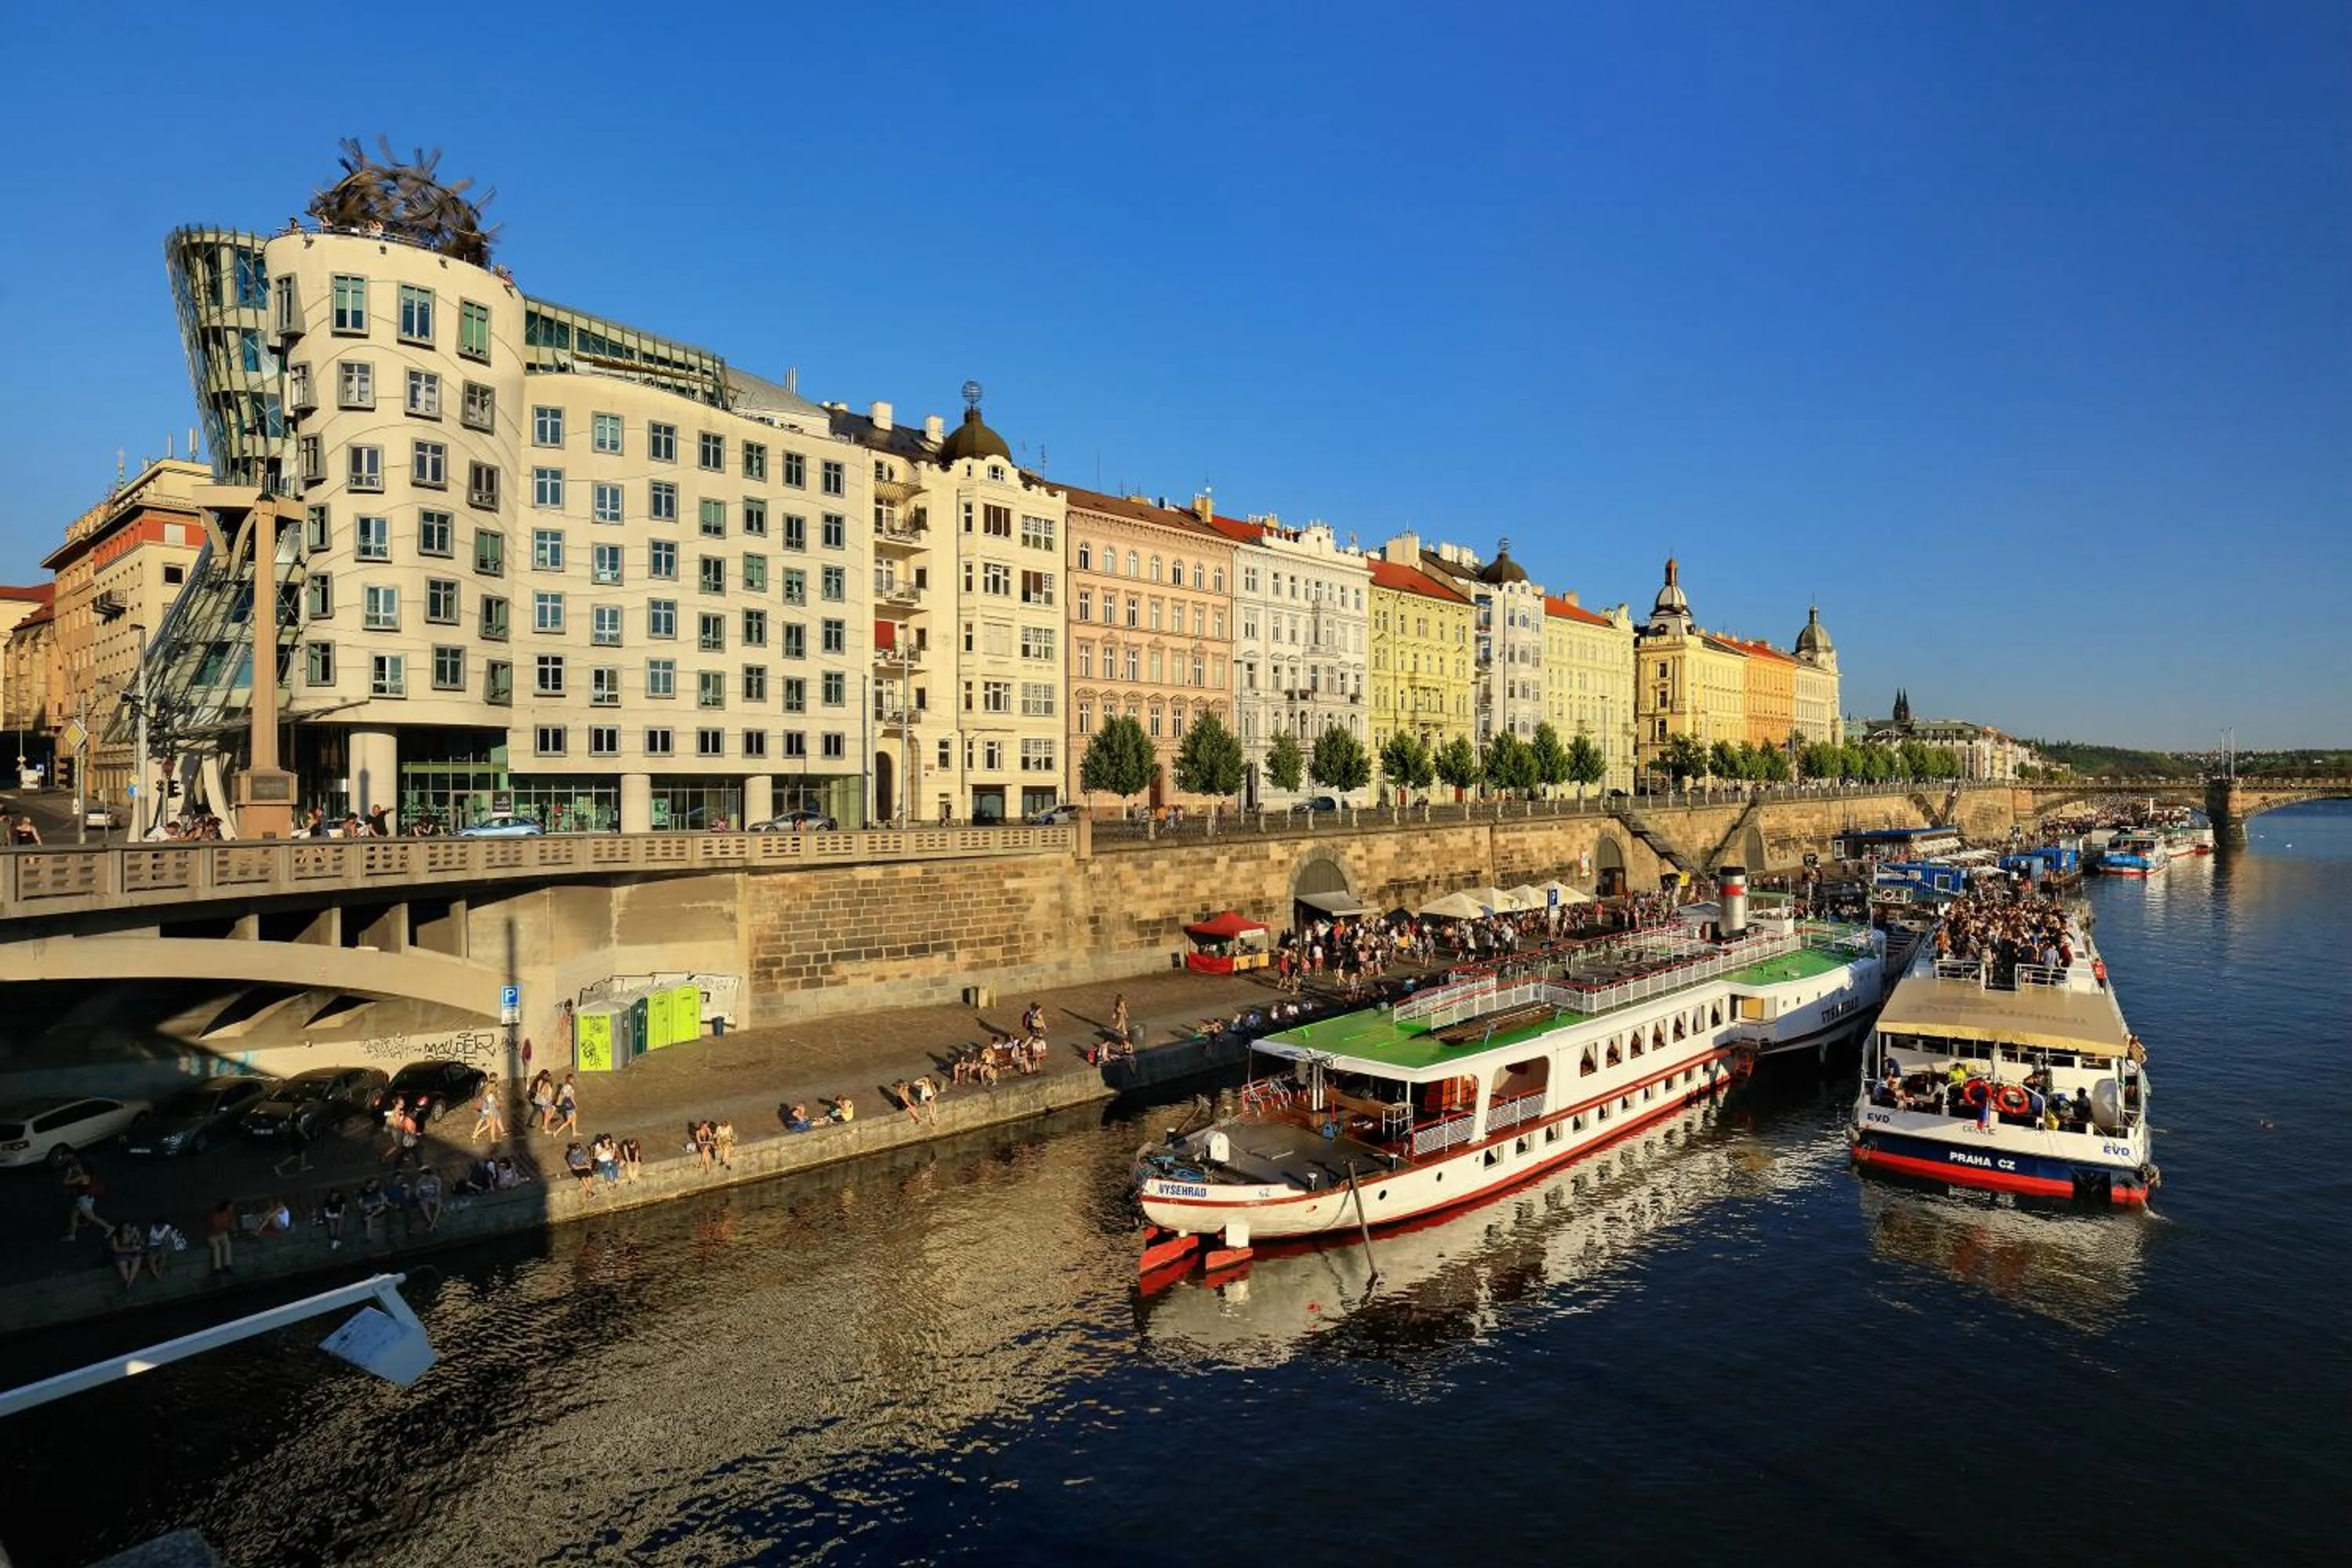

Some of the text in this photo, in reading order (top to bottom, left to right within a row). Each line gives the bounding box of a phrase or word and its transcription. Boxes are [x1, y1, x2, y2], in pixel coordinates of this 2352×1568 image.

[506, 989, 515, 1004] P
[1867, 1112, 1890, 1123] EVD
[2103, 1145, 2130, 1156] EVD
[1950, 1151, 2016, 1171] PRAHA CZ
